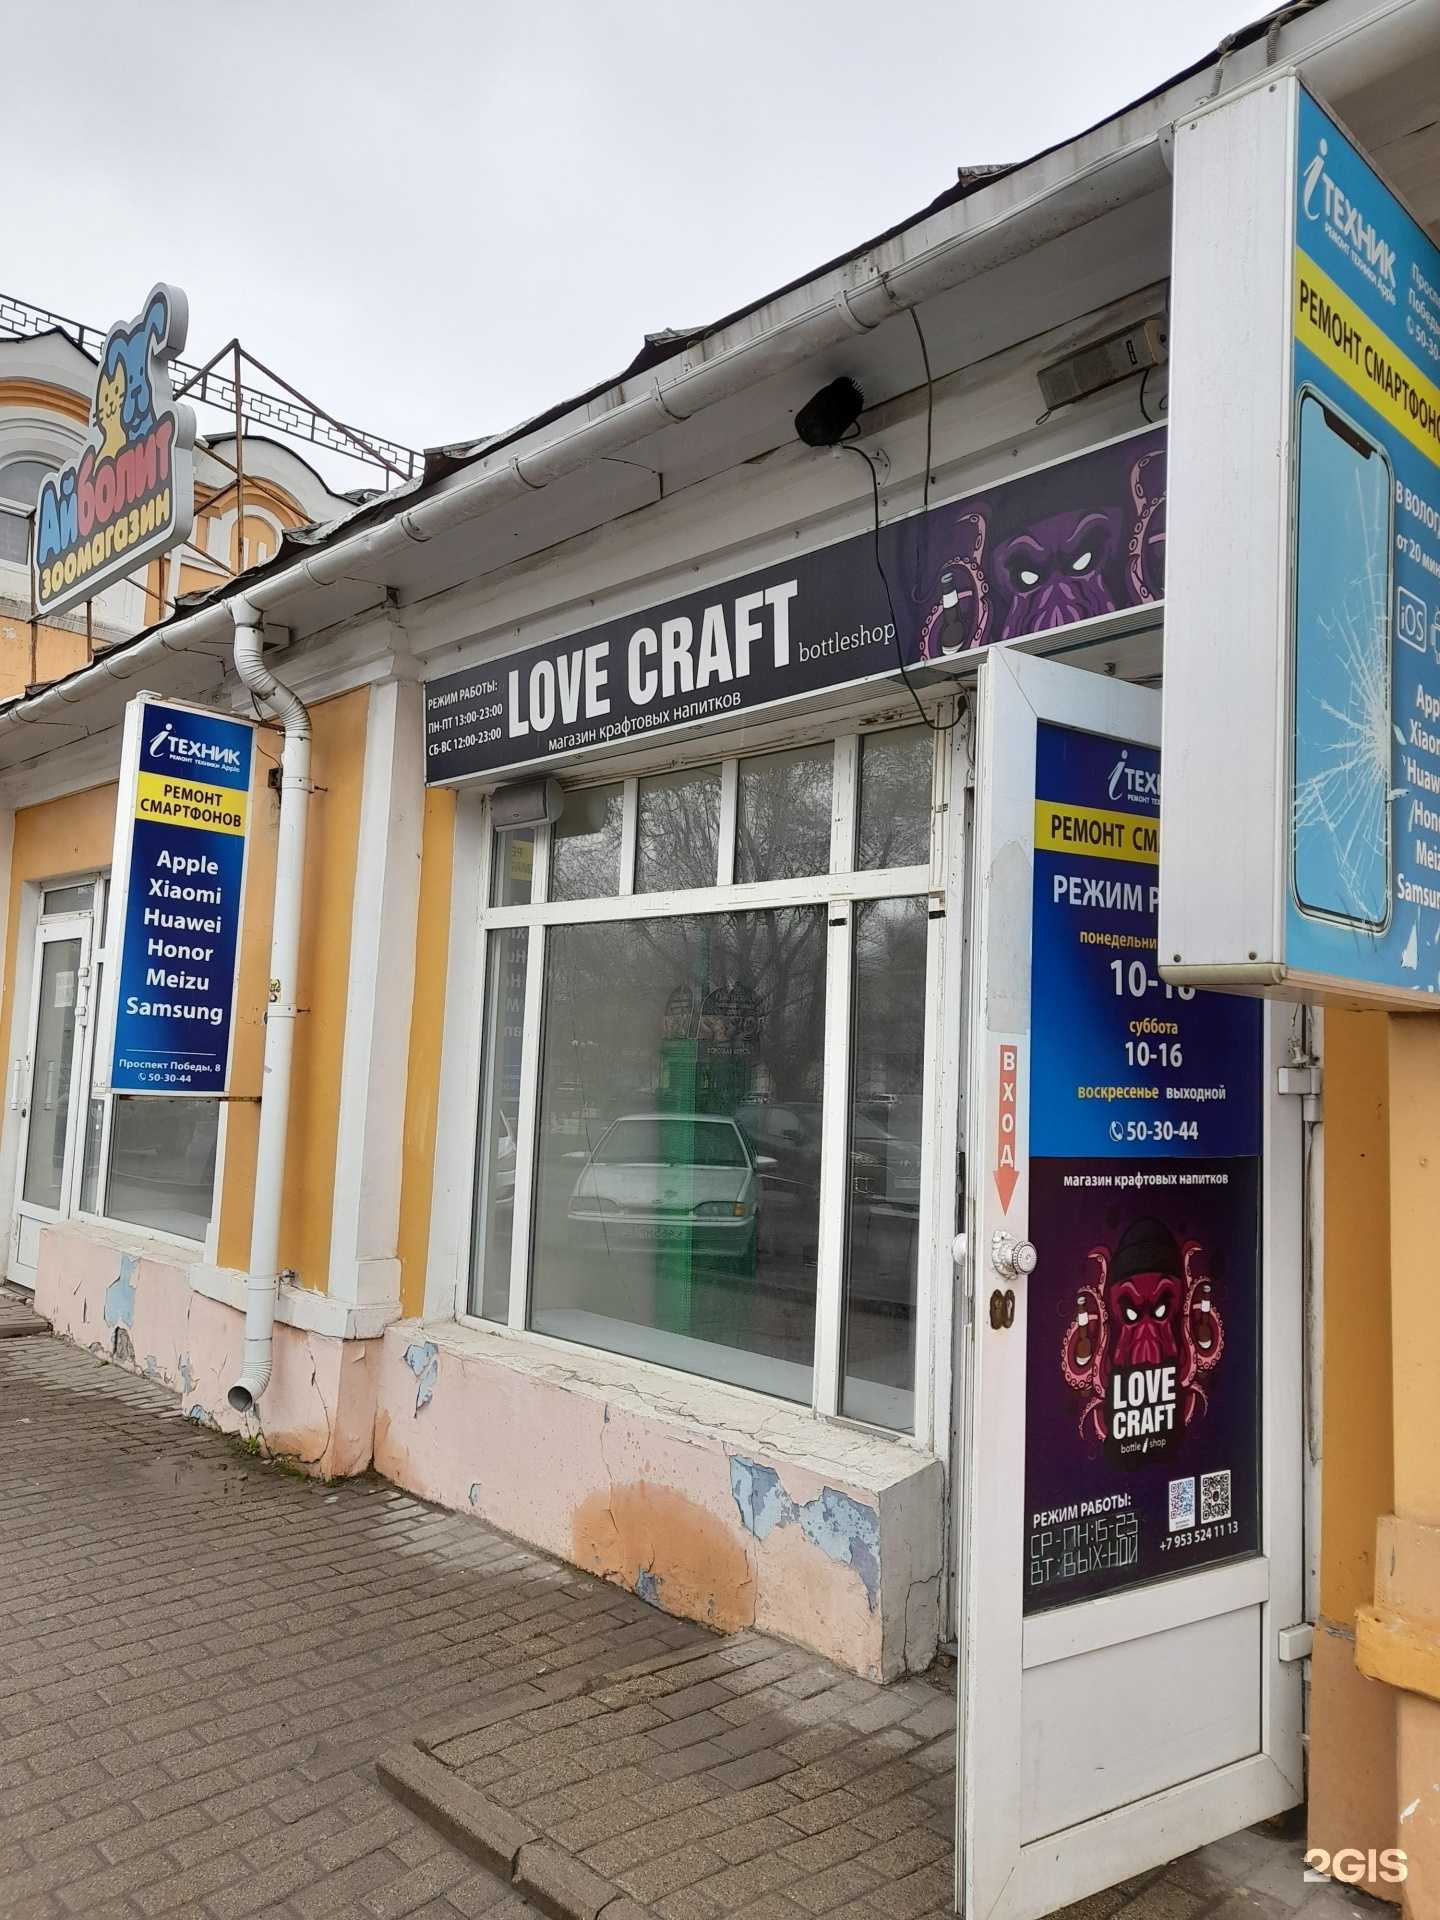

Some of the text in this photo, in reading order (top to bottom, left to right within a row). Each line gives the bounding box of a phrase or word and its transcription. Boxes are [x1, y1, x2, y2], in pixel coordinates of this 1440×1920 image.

[1299, 279, 1361, 365] РЕМОНТ
[1397, 534, 1408, 552] от
[1409, 539, 1421, 562] 20
[1401, 604, 1425, 641] iOS
[798, 622, 896, 663] bottleshop
[508, 579, 798, 738] LOVE CRAFT
[428, 680, 498, 710] РЕЖИМ РАБОТЫ:
[1416, 684, 1440, 722] App
[428, 703, 503, 734] ПН-ПТ 13:00-23:00
[549, 692, 741, 751] магазин крафтовых напитков
[429, 727, 502, 756] СБ-ВС 12:00-23:00
[163, 784, 223, 806] РЕМОНТ
[140, 798, 241, 827] СМАРТФОНОВ
[1414, 800, 1440, 832] Hon
[1051, 814, 1160, 853] РЕМОНТ СМ
[156, 850, 219, 875] Apple
[148, 878, 221, 904] Xiaomi
[1053, 875, 1143, 912] РЕЖИМ
[143, 908, 222, 933] Huawei
[147, 938, 214, 961] Honor
[146, 968, 209, 990] Meizu
[126, 997, 223, 1025] Samsung
[1129, 1017, 1178, 1036] суббота
[119, 1058, 221, 1073] Проспект Победы, 8
[1125, 1041, 1183, 1067] 10-16
[148, 1073, 192, 1083] 50-30-44
[1078, 1085, 1226, 1102] воскресенье выходной
[1126, 1121, 1199, 1141] 50-30-44
[1063, 1171, 1229, 1189] магазин крафтовых напитков
[1113, 1366, 1176, 1410] LOVE
[1113, 1403, 1176, 1439] CRAFT
[1120, 1438, 1167, 1454] bottle shop
[1033, 1493, 1132, 1528] РЕЖИМ РАБОТЫ:
[1160, 1521, 1238, 1551] +7 953 524 11 13
